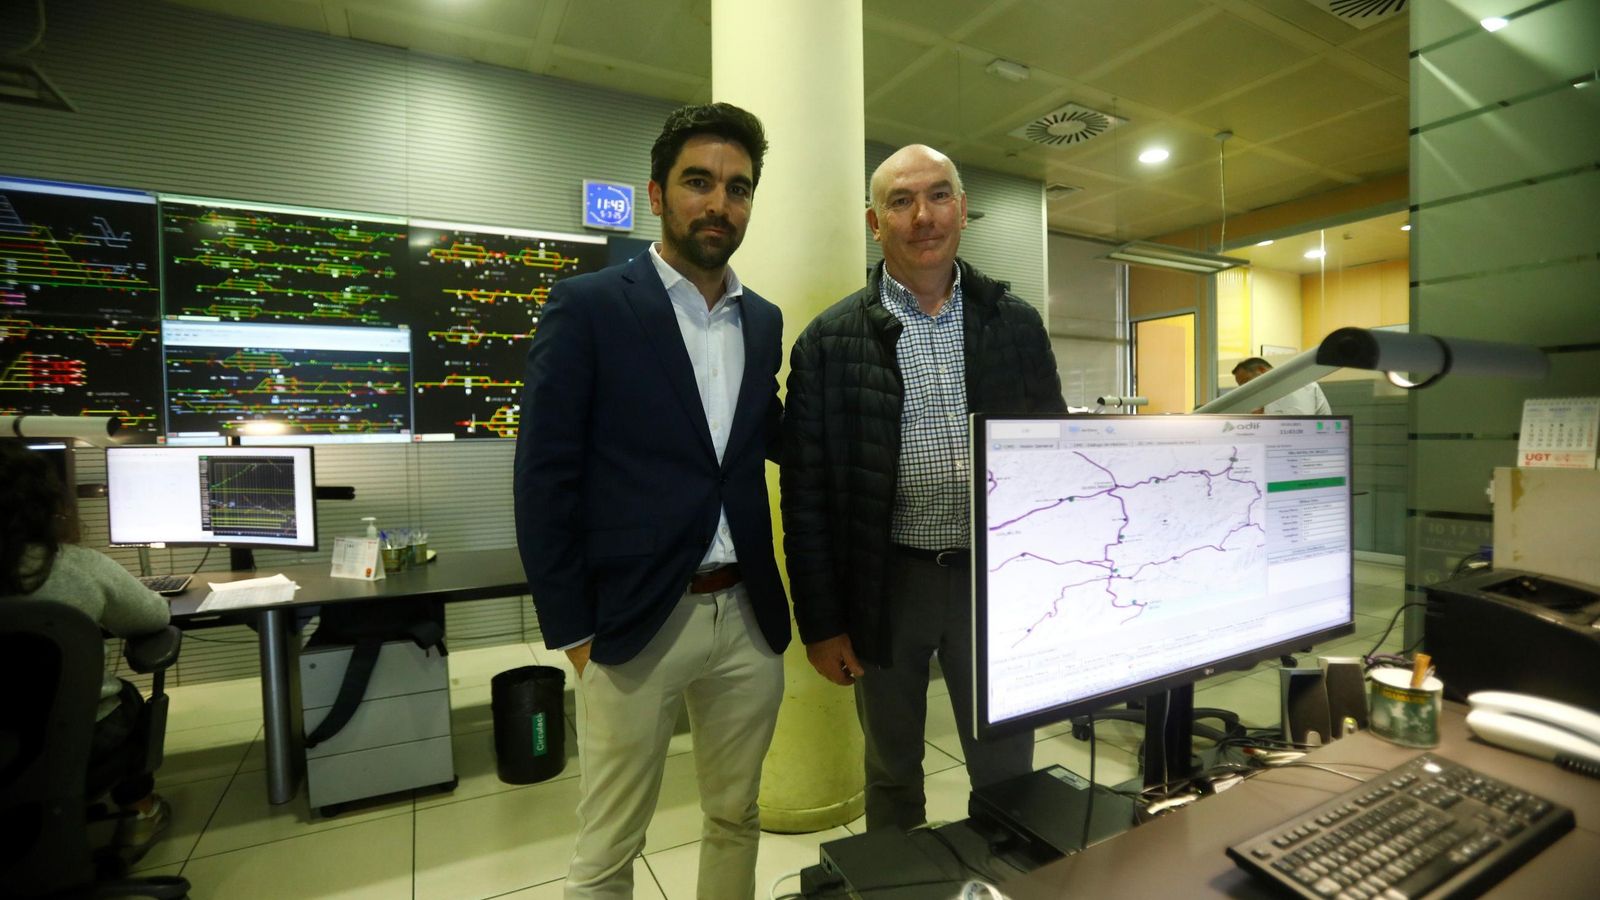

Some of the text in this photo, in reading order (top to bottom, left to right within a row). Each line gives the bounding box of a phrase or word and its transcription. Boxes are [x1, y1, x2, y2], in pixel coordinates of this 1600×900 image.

[597, 198, 625, 212] 11:43
[1237, 421, 1261, 430] adif
[1525, 453, 1552, 461] UGT
